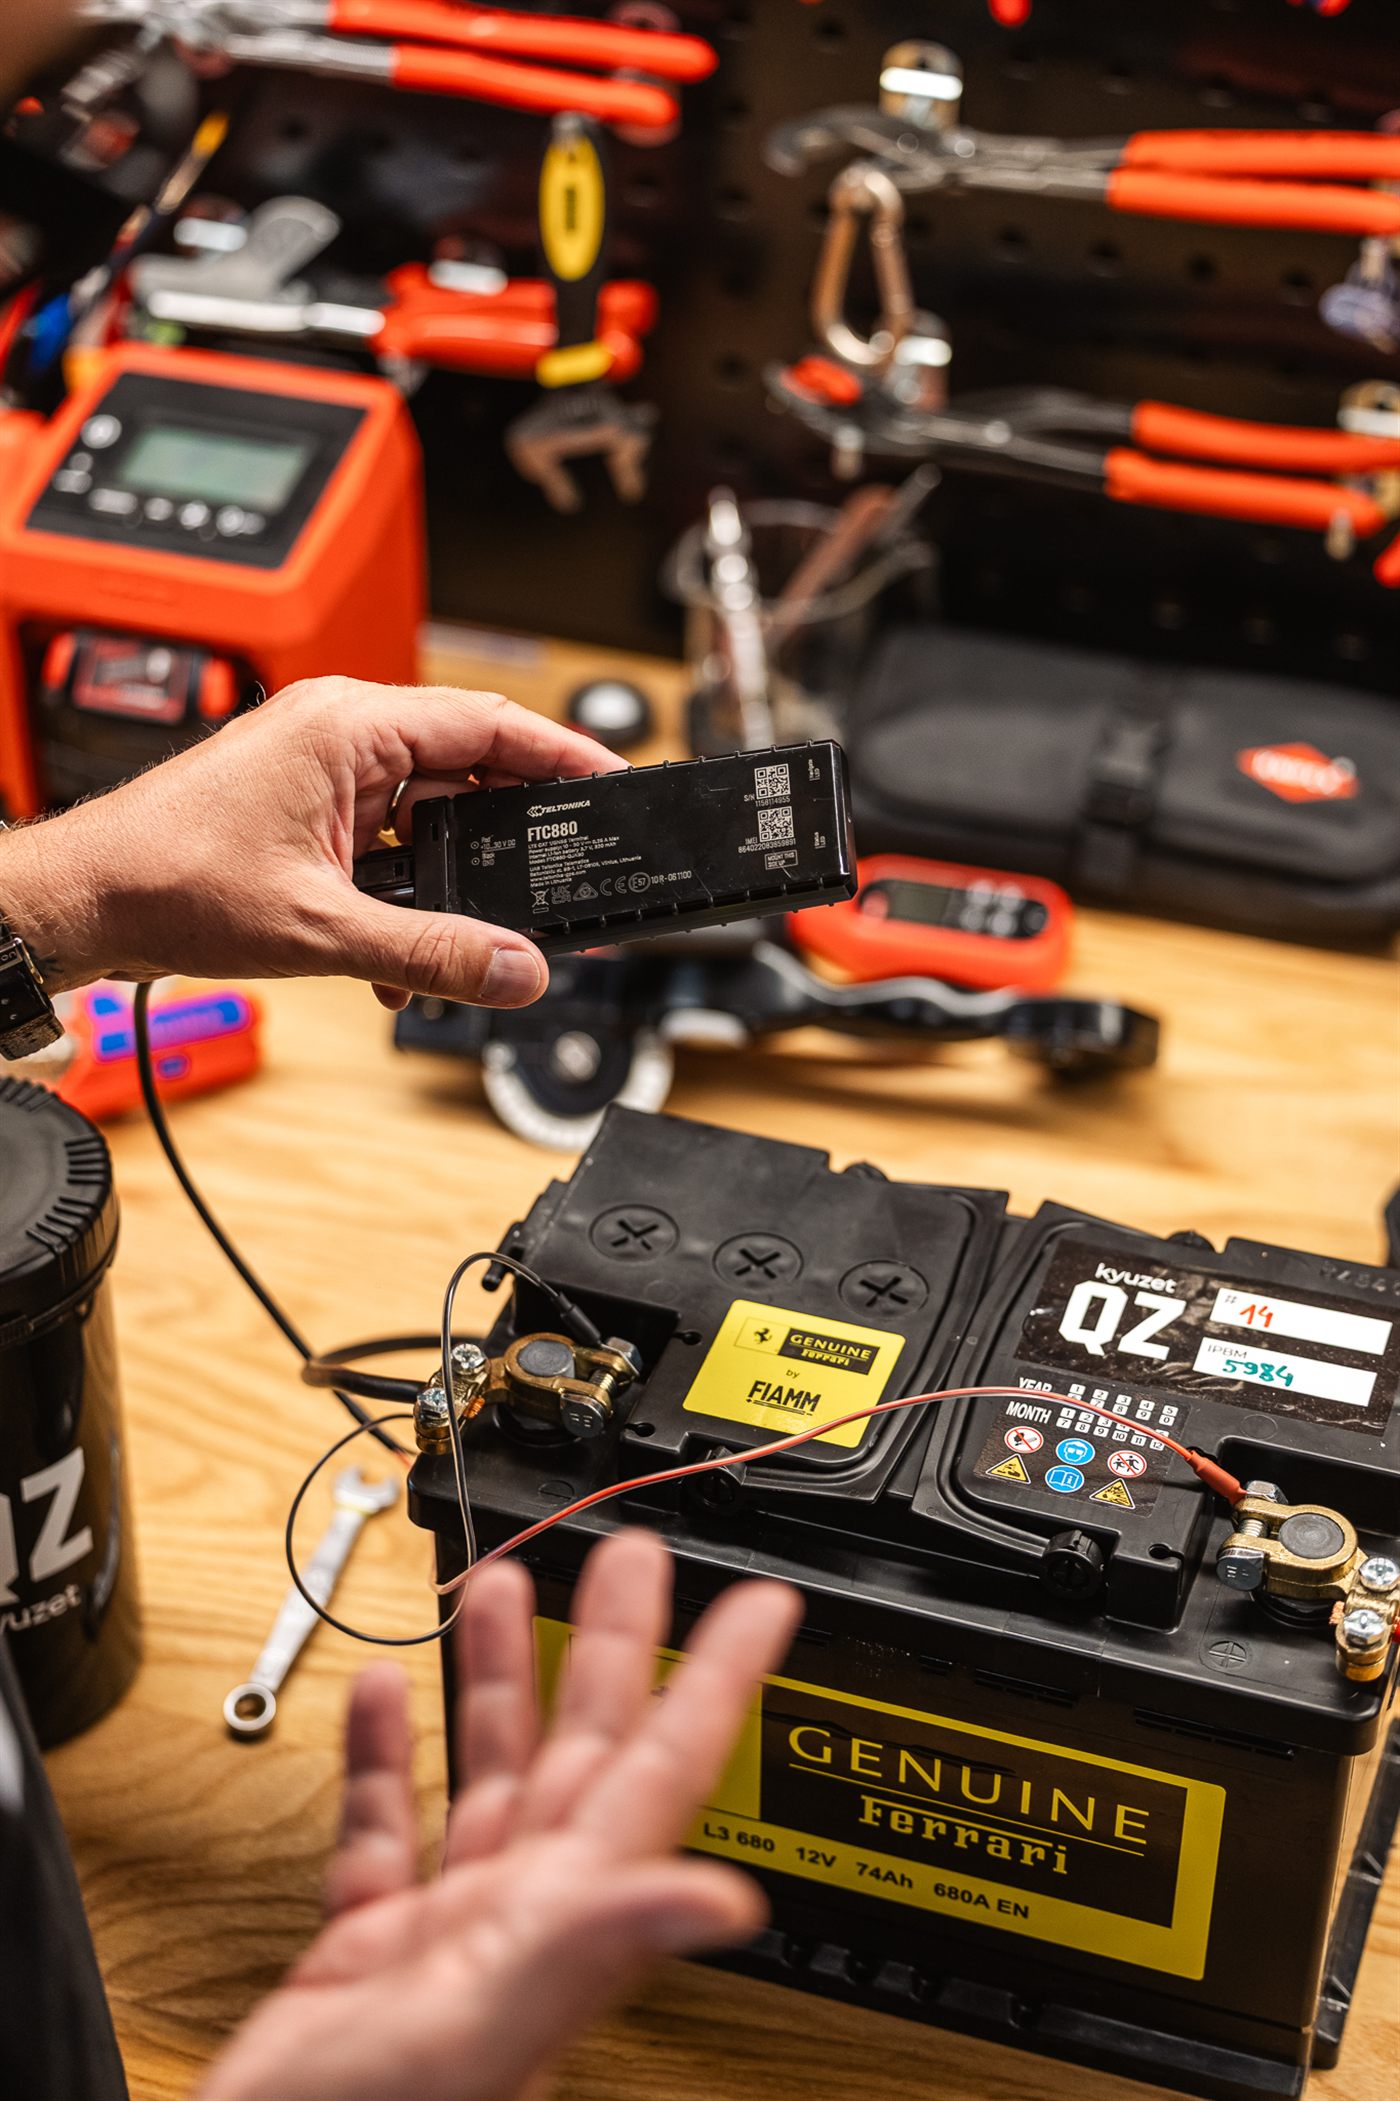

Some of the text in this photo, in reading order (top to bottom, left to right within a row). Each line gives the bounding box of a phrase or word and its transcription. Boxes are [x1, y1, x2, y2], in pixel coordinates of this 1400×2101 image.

[542, 800, 591, 814] TELTONIKA
[527, 821, 578, 842] FTC880
[1095, 1262, 1178, 1294] kyuzet
[1224, 1294, 1237, 1304] #
[1059, 1280, 1187, 1361] QZ
[1239, 1303, 1274, 1329] 14
[790, 1334, 872, 1360] GENUINE
[1207, 1344, 1248, 1359] IPBM
[786, 1369, 800, 1379] by
[1019, 1377, 1053, 1392] YEAR
[1222, 1359, 1294, 1387] 5984
[748, 1380, 822, 1412] FIAMM
[1006, 1401, 1052, 1424] MONTH
[788, 1725, 1150, 1845] GENUINE
[858, 1794, 1068, 1875] Ferrari
[703, 1822, 1030, 1920] L3 680 12V 74Ah 680A EN
